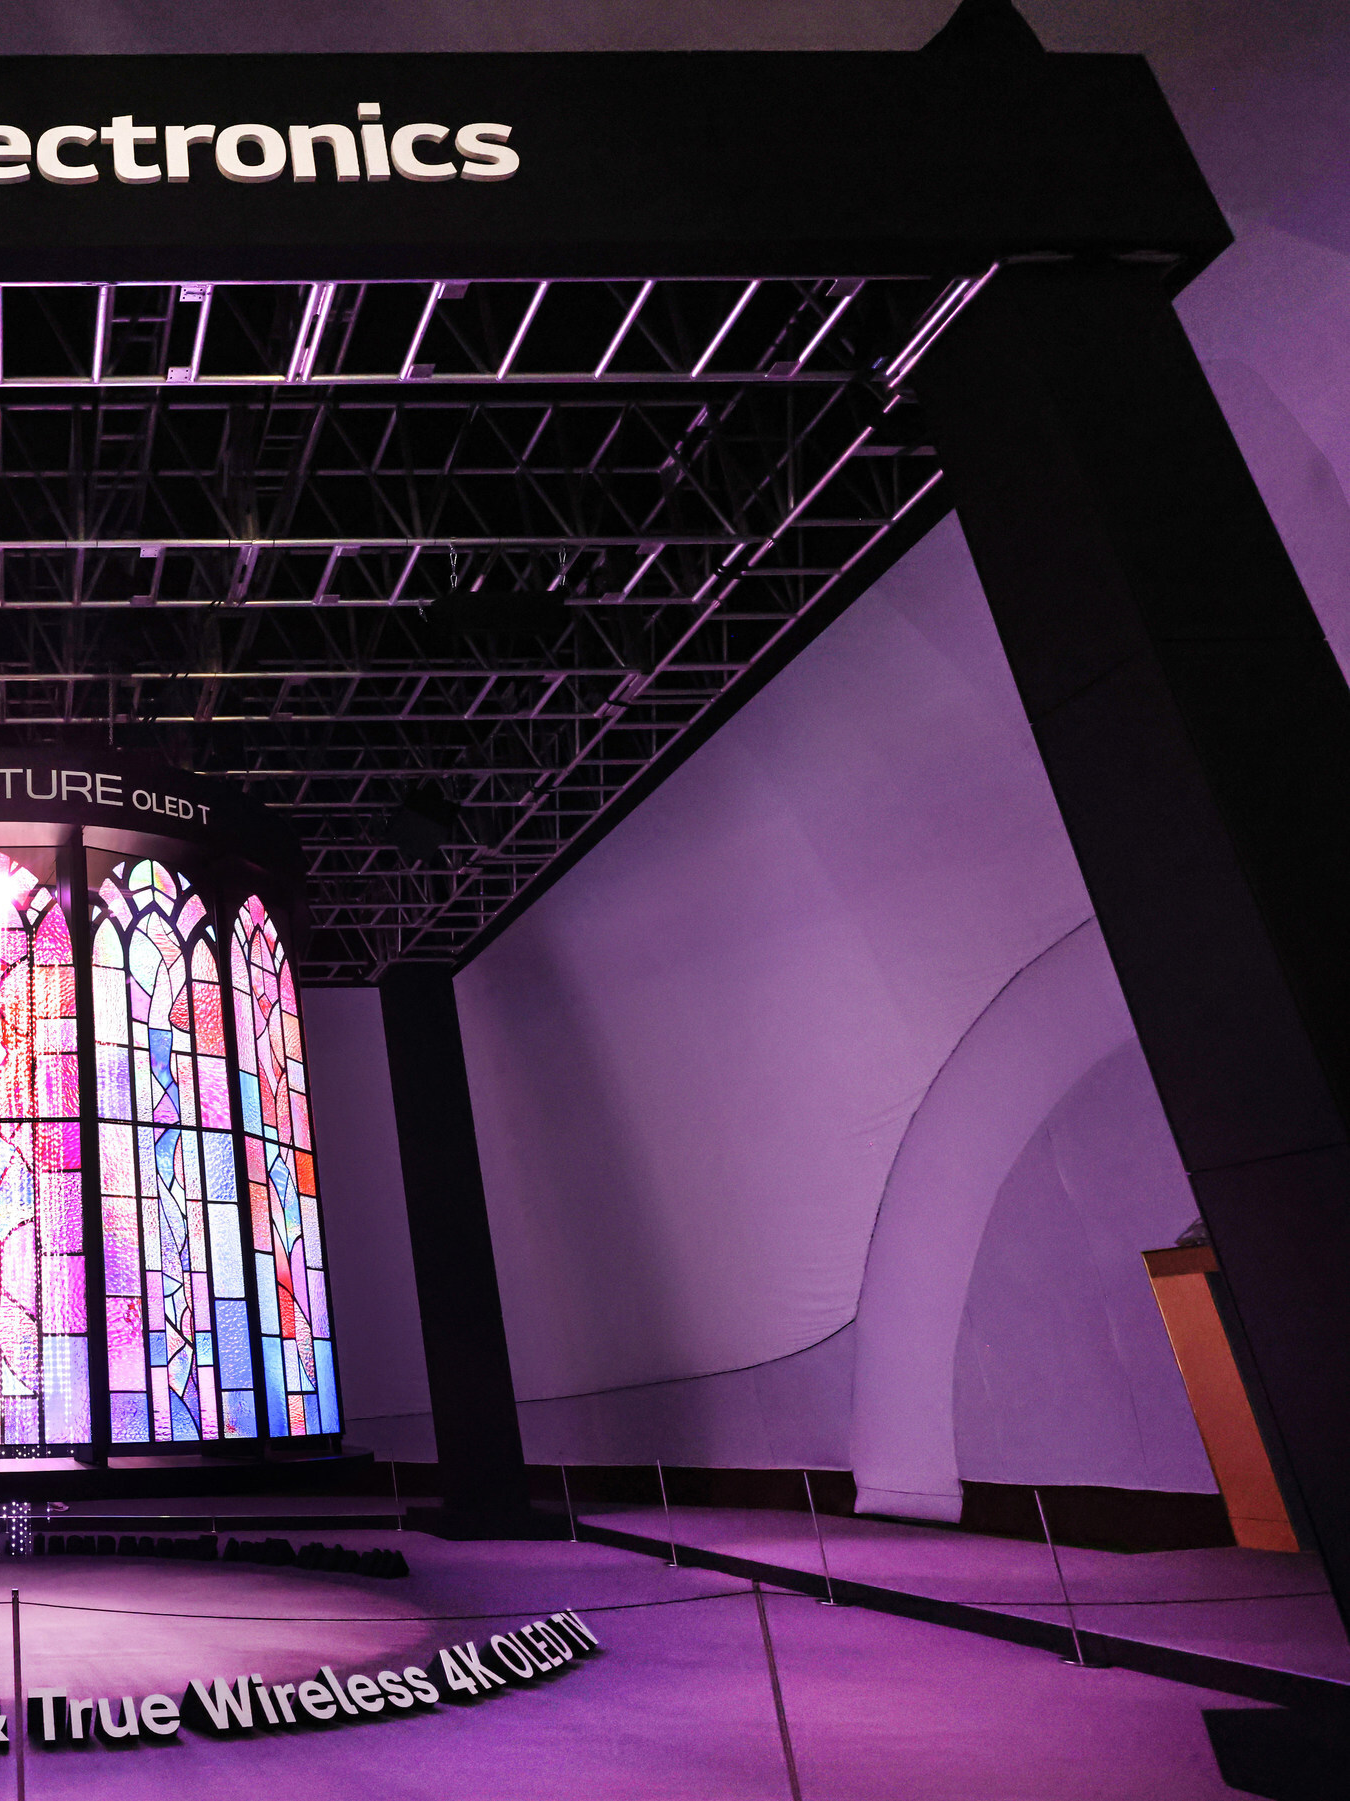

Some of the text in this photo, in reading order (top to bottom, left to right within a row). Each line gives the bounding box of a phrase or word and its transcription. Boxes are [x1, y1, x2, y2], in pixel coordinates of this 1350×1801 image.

[132, 789, 194, 819] OLED
[197, 804, 210, 825] T
[28, 1688, 181, 1741] True
[190, 1666, 439, 1729] Wireless
[438, 1640, 505, 1695] 4K
[491, 1620, 575, 1678] OLED
[553, 1608, 600, 1651] TV
